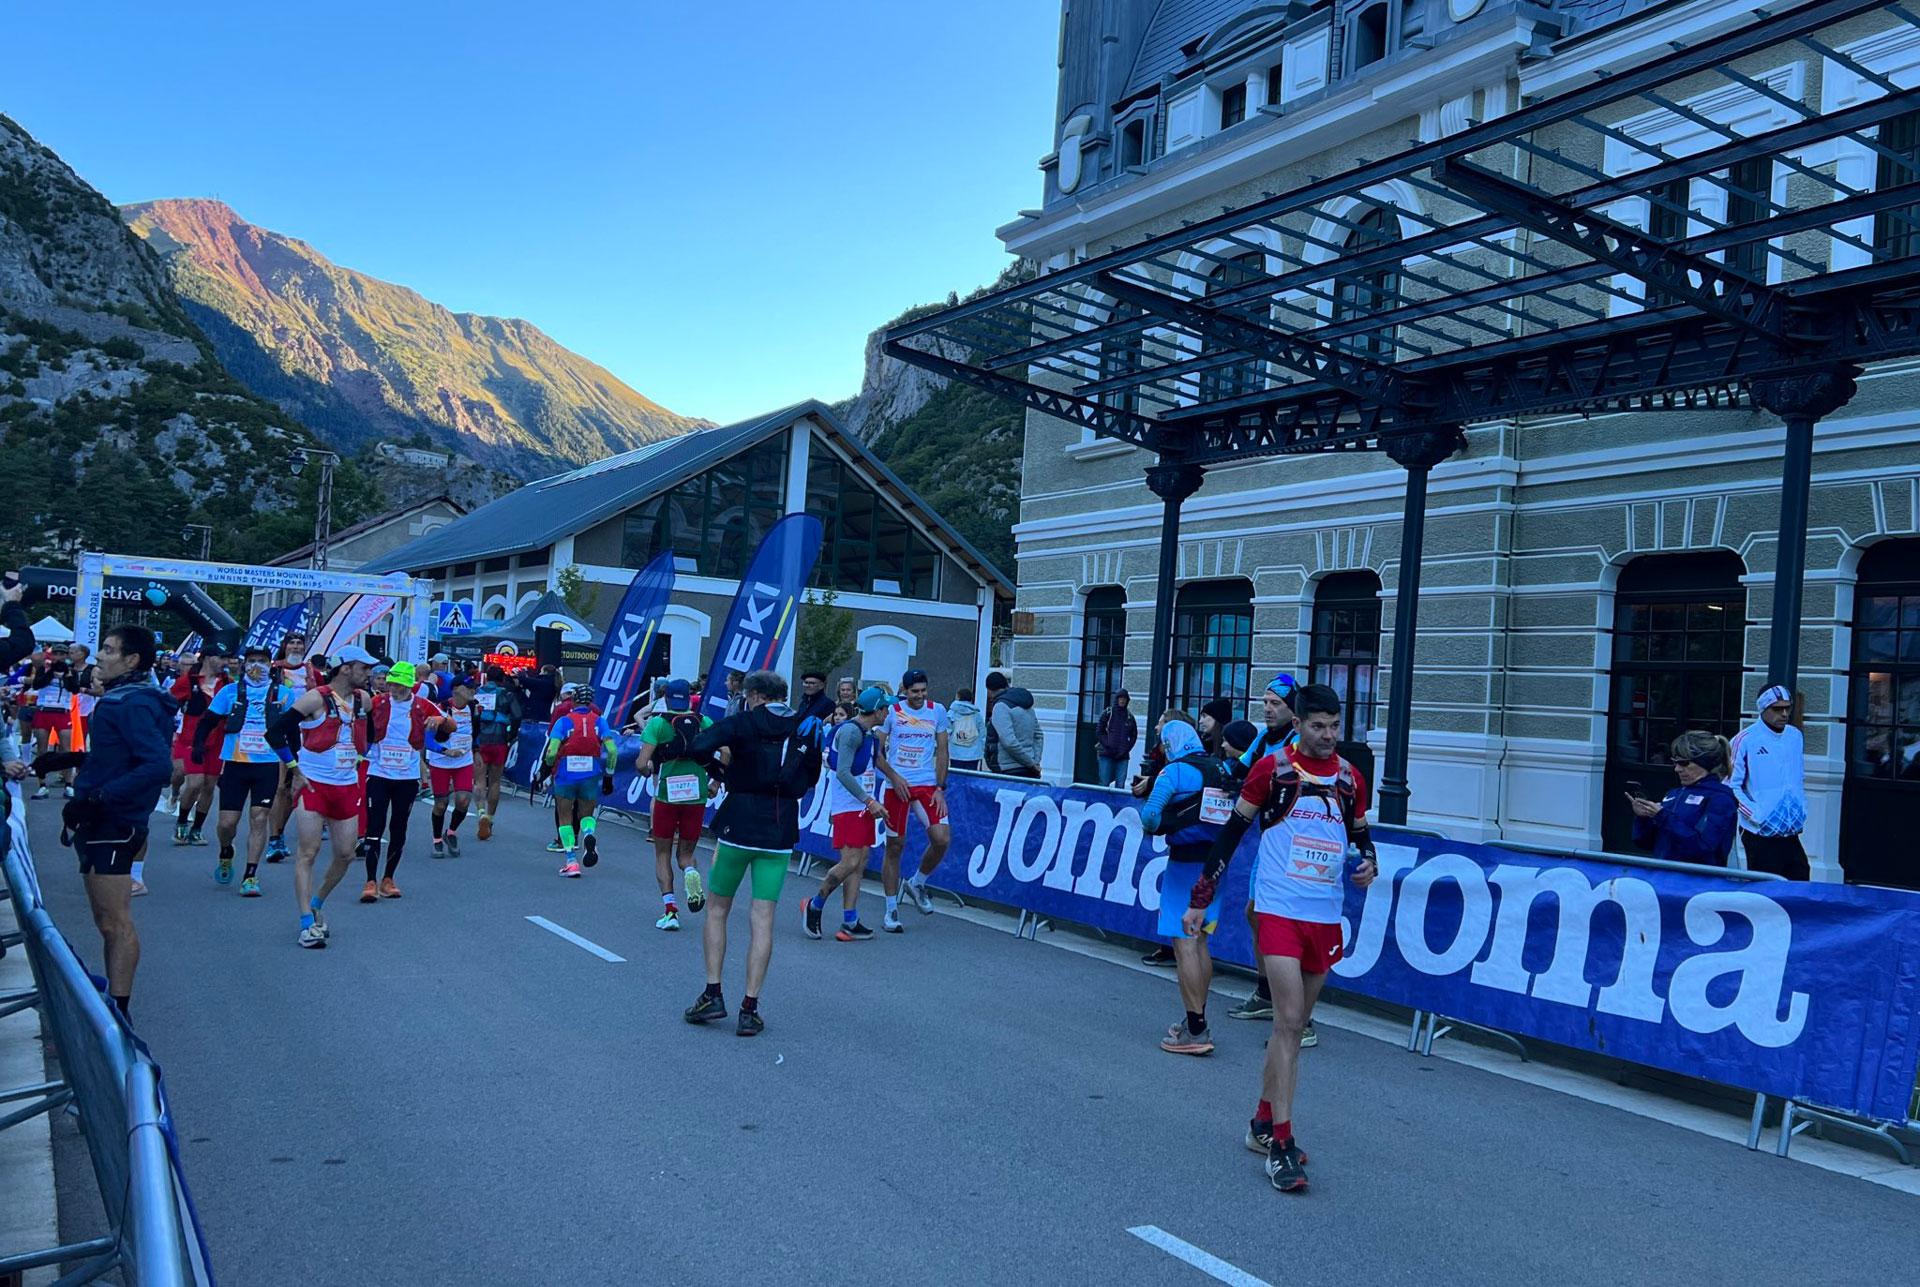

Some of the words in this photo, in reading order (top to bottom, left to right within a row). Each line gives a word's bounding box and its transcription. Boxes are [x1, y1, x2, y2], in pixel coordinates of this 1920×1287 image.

[217, 567, 242, 575] WORLD
[1305, 850, 1328, 862] 1170
[1330, 842, 1810, 1048] Joma
